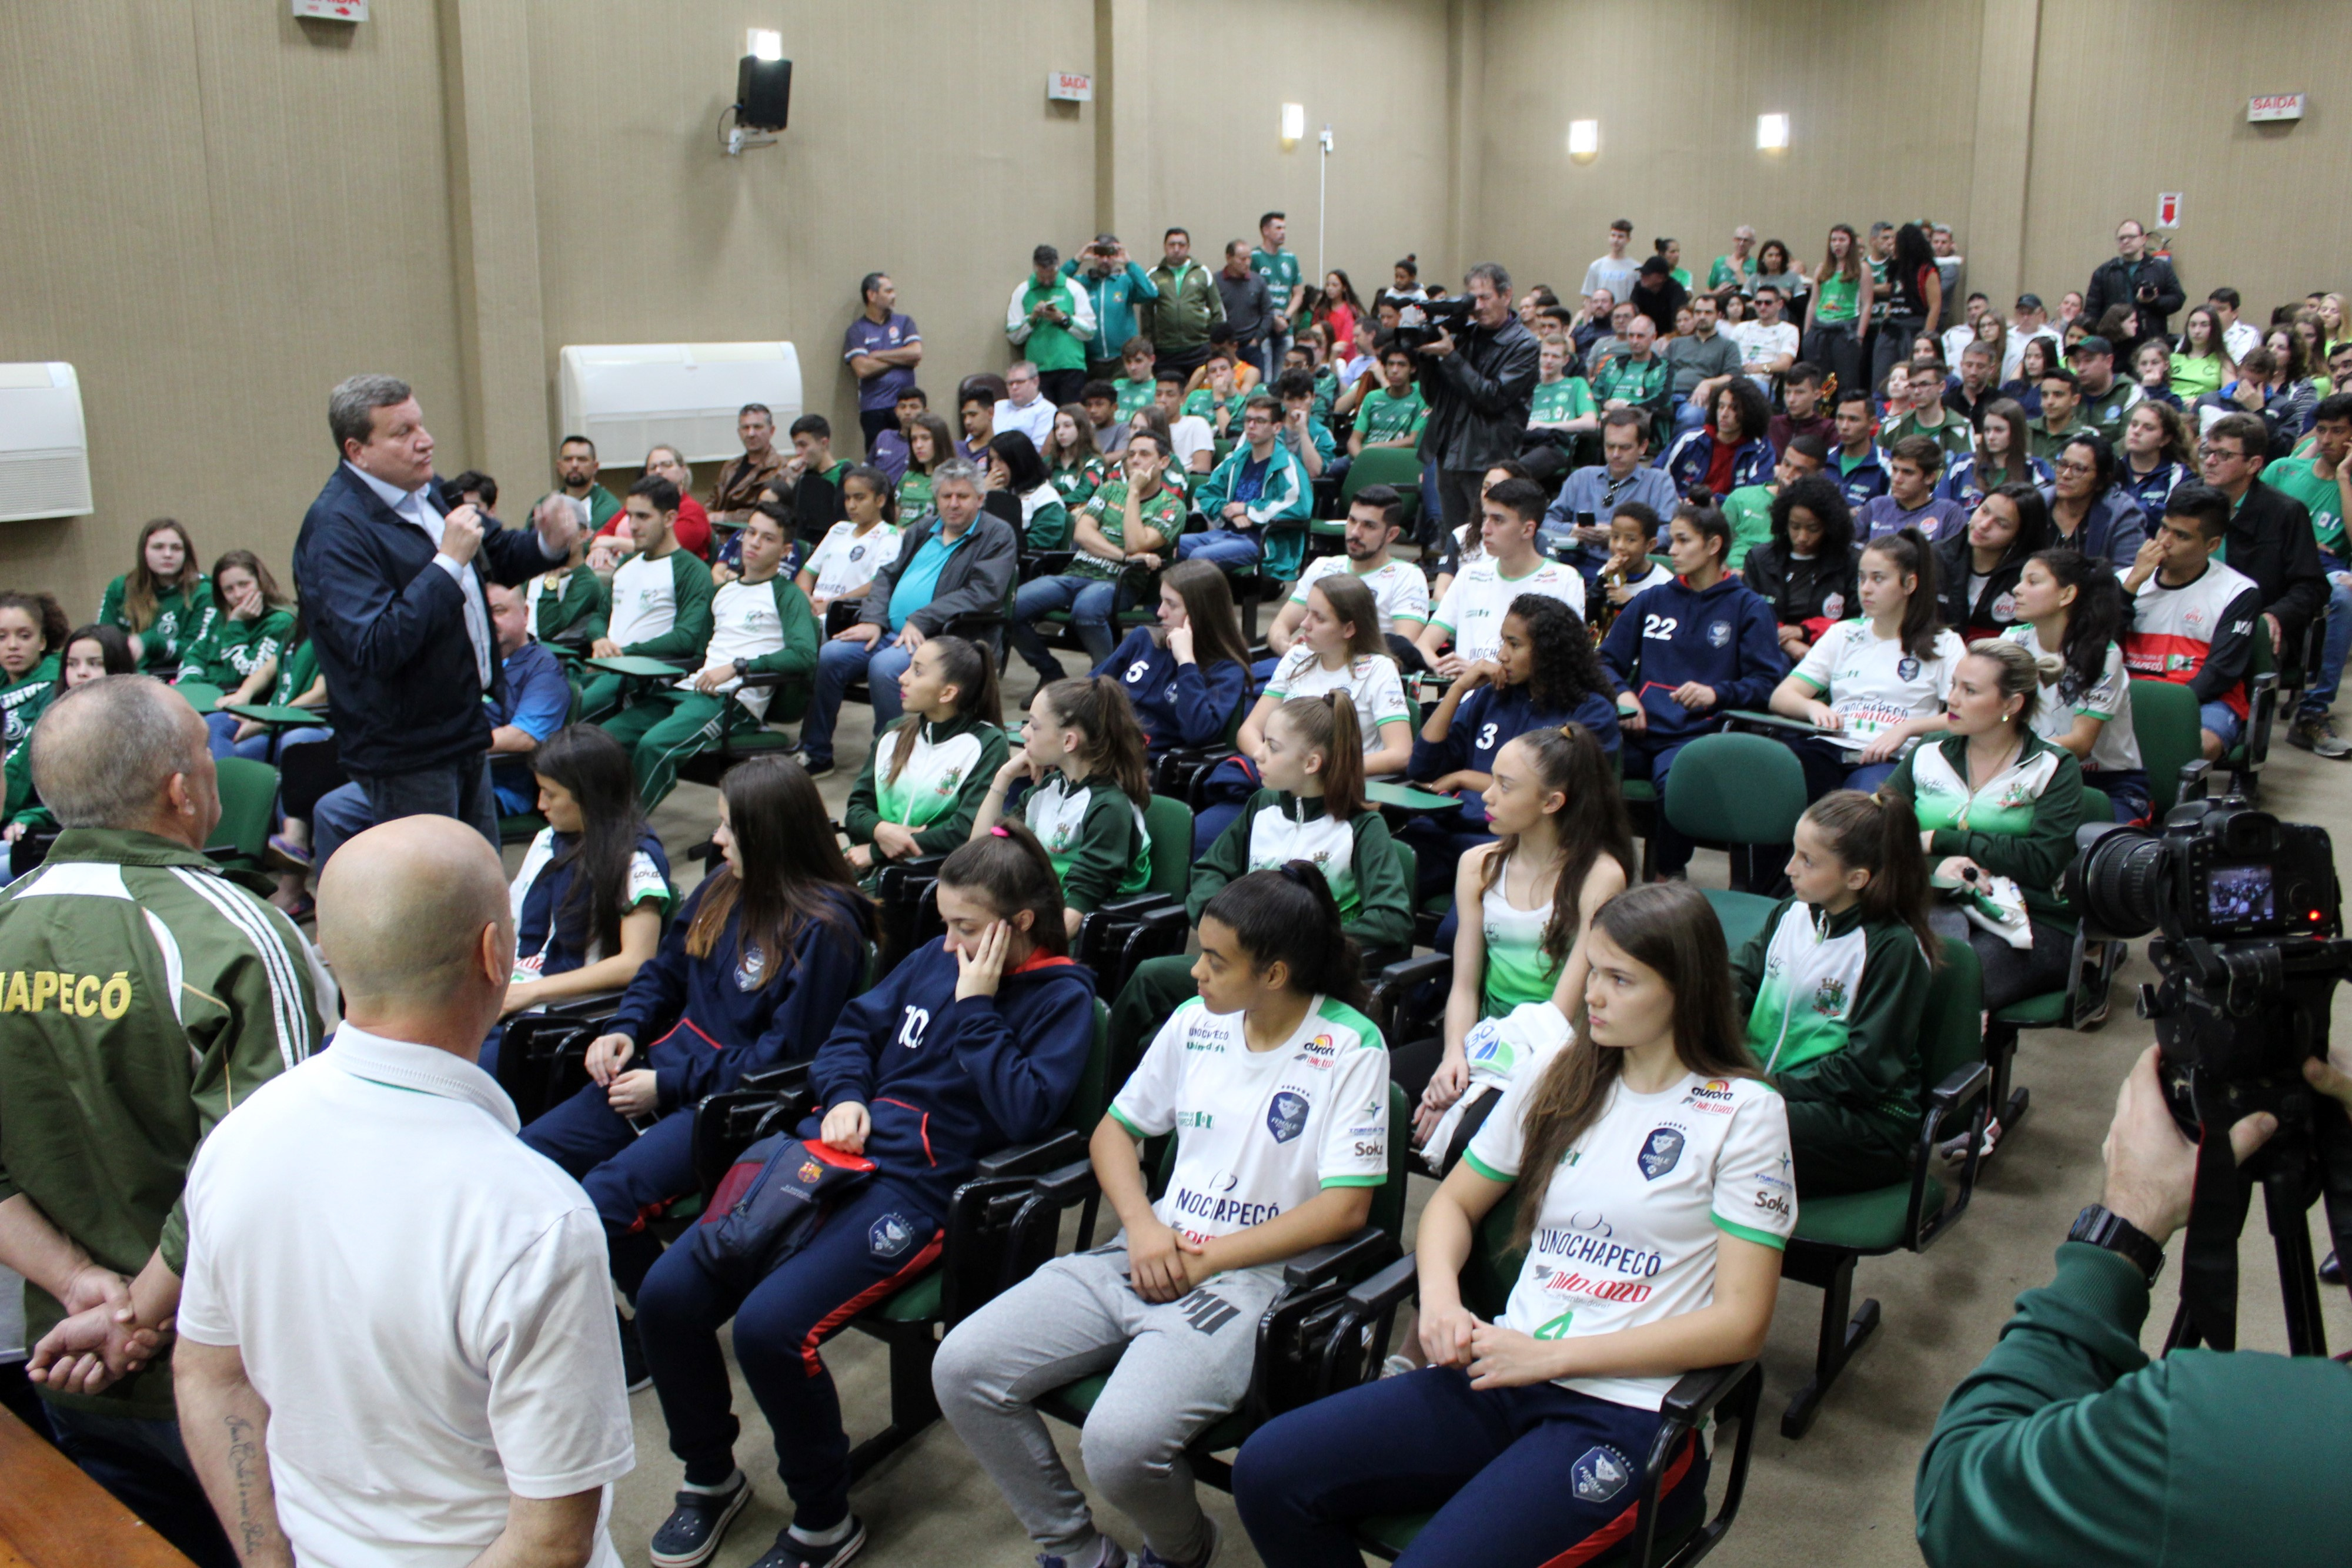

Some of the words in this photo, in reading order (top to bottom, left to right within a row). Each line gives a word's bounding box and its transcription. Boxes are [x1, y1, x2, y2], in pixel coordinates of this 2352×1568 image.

[1643, 613, 1678, 640] 22
[1476, 723, 1499, 750] 3
[0, 971, 132, 1021] APECÓ
[898, 1005, 930, 1049] 10
[1691, 1086, 1734, 1101] aurora
[1539, 1228, 1662, 1278] UNOCHAPECÓ
